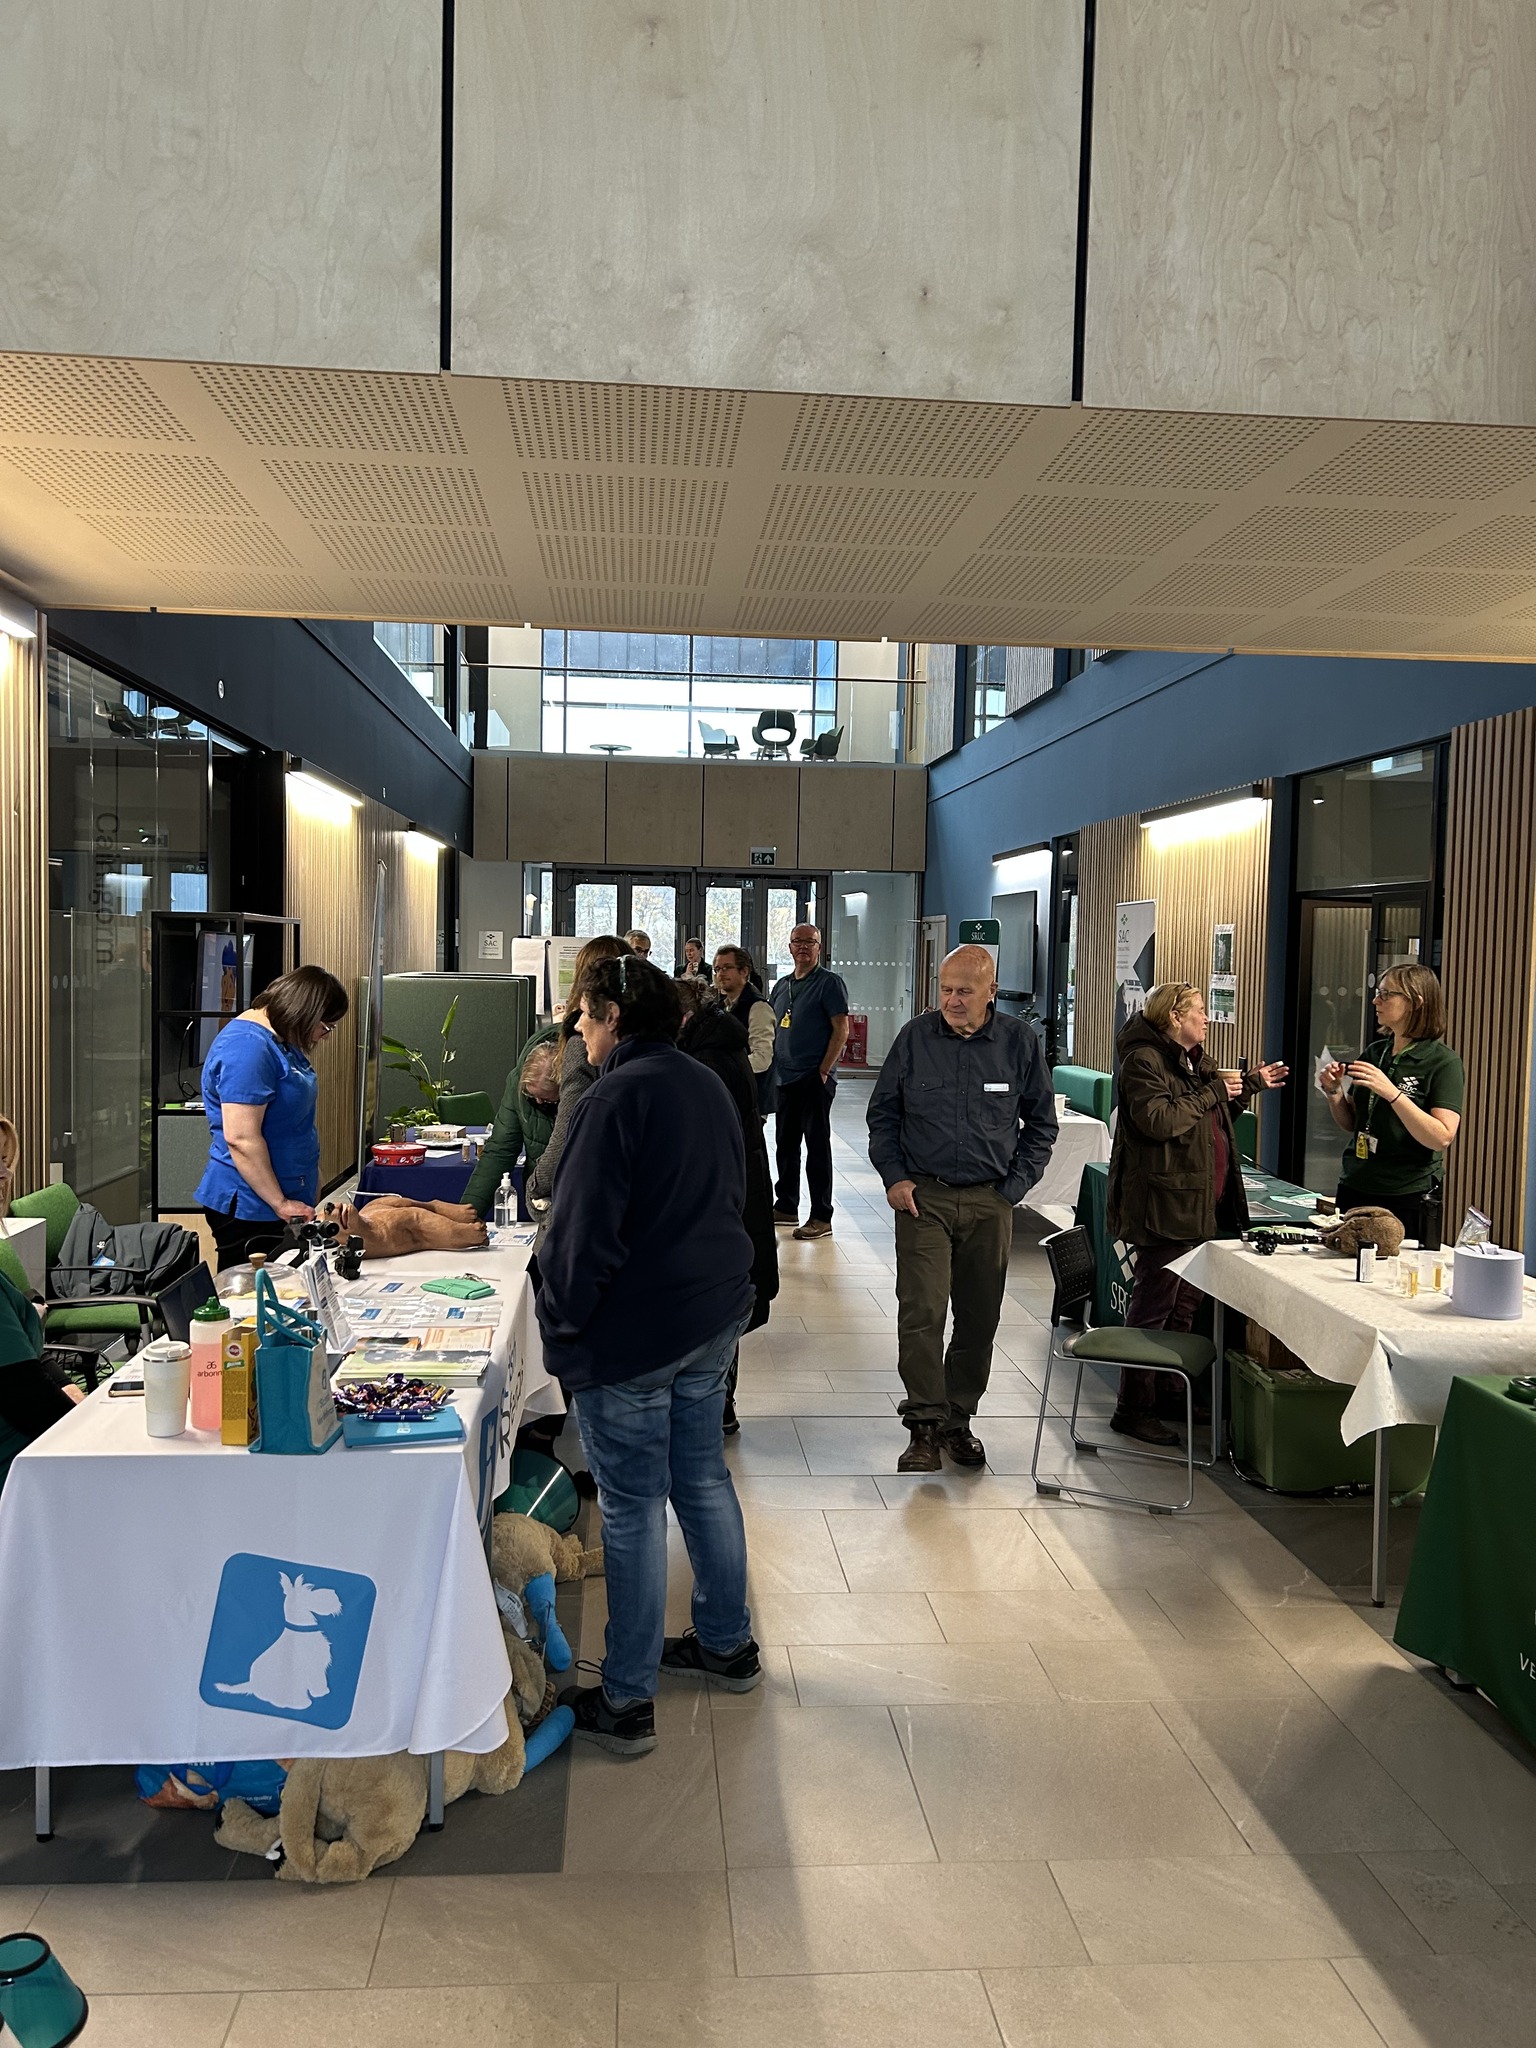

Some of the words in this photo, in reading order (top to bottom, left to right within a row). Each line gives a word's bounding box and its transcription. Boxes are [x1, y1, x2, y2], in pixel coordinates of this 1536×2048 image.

[89, 812, 120, 964] Cairngorm
[971, 932, 986, 941] SRUC
[1118, 929, 1130, 943] SAC
[1397, 1082, 1417, 1094] SRUC
[1110, 1281, 1133, 1320] SR
